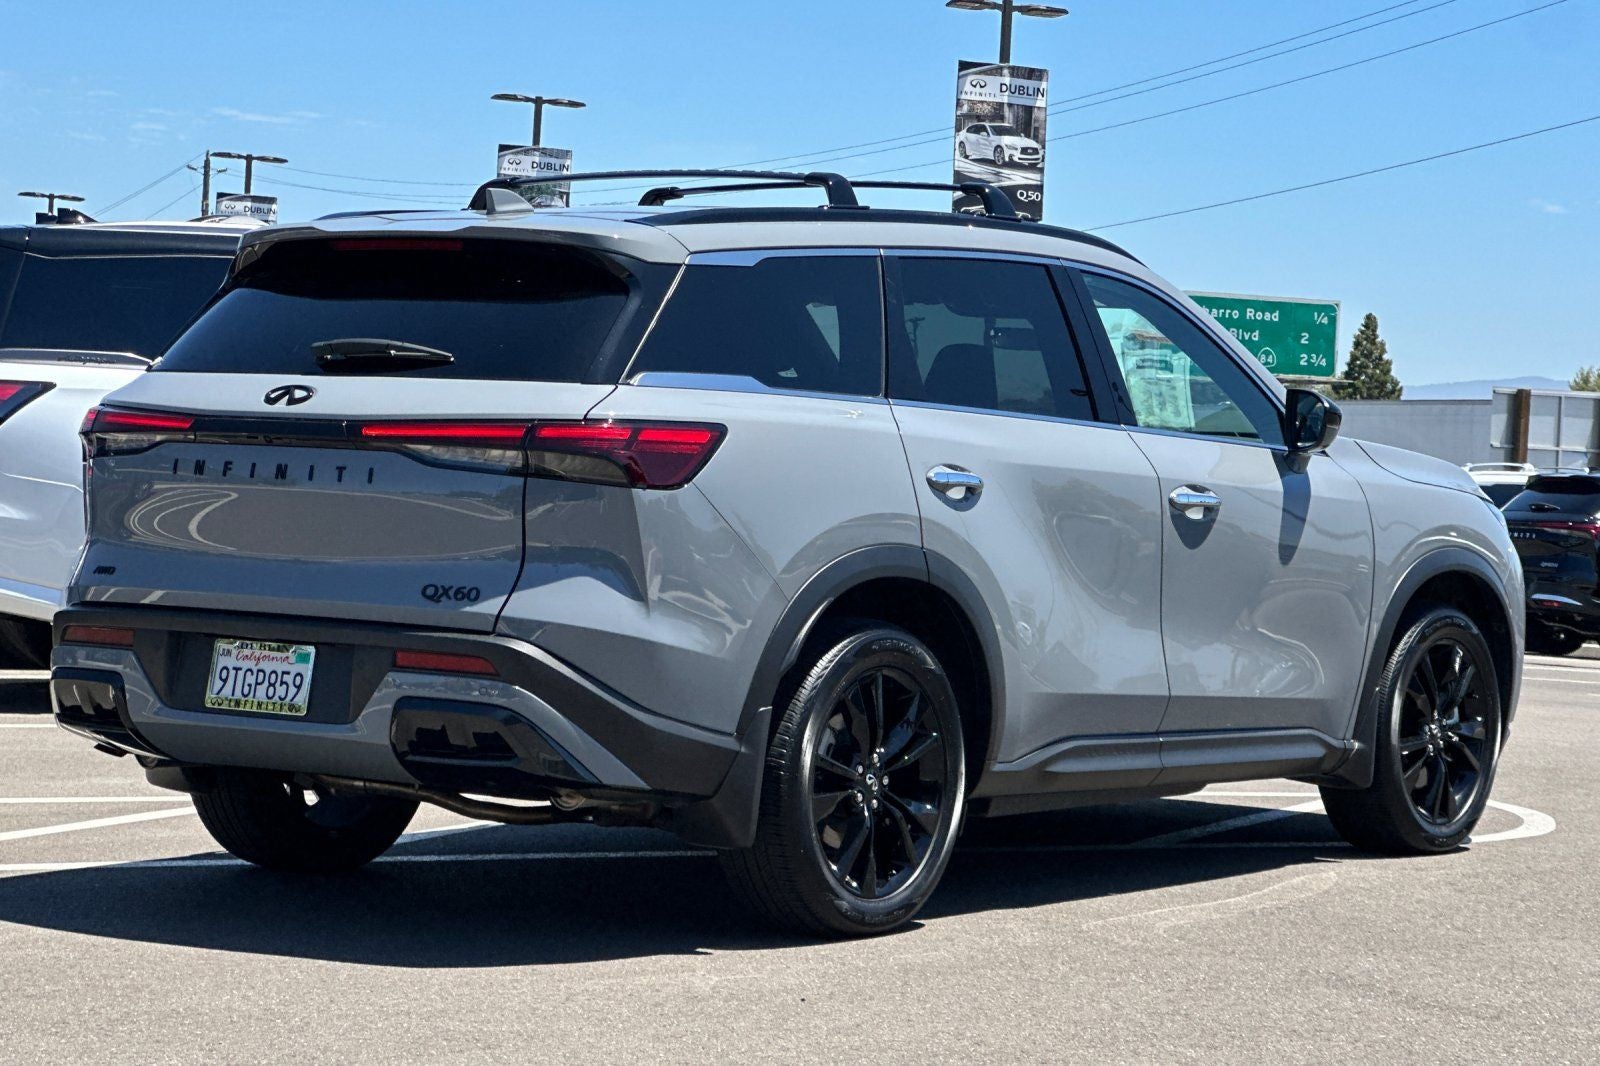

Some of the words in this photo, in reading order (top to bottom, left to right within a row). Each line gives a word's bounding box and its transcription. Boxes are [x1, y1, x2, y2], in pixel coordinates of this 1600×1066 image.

[960, 90, 997, 98] INFINITI
[999, 82, 1045, 98] DUBLIN
[531, 160, 570, 172] DUBLIN
[1017, 189, 1041, 202] Q50
[243, 205, 276, 215] DUBLIN
[1246, 308, 1280, 322] Road
[1229, 328, 1260, 341] Blvd
[1300, 332, 1310, 344] 2
[1260, 354, 1273, 364] 84
[172, 458, 374, 484] INFINITI
[421, 584, 481, 603] QX60
[235, 649, 296, 666] California
[216, 665, 304, 702] 9TGP859
[228, 698, 285, 713] INFINITI
